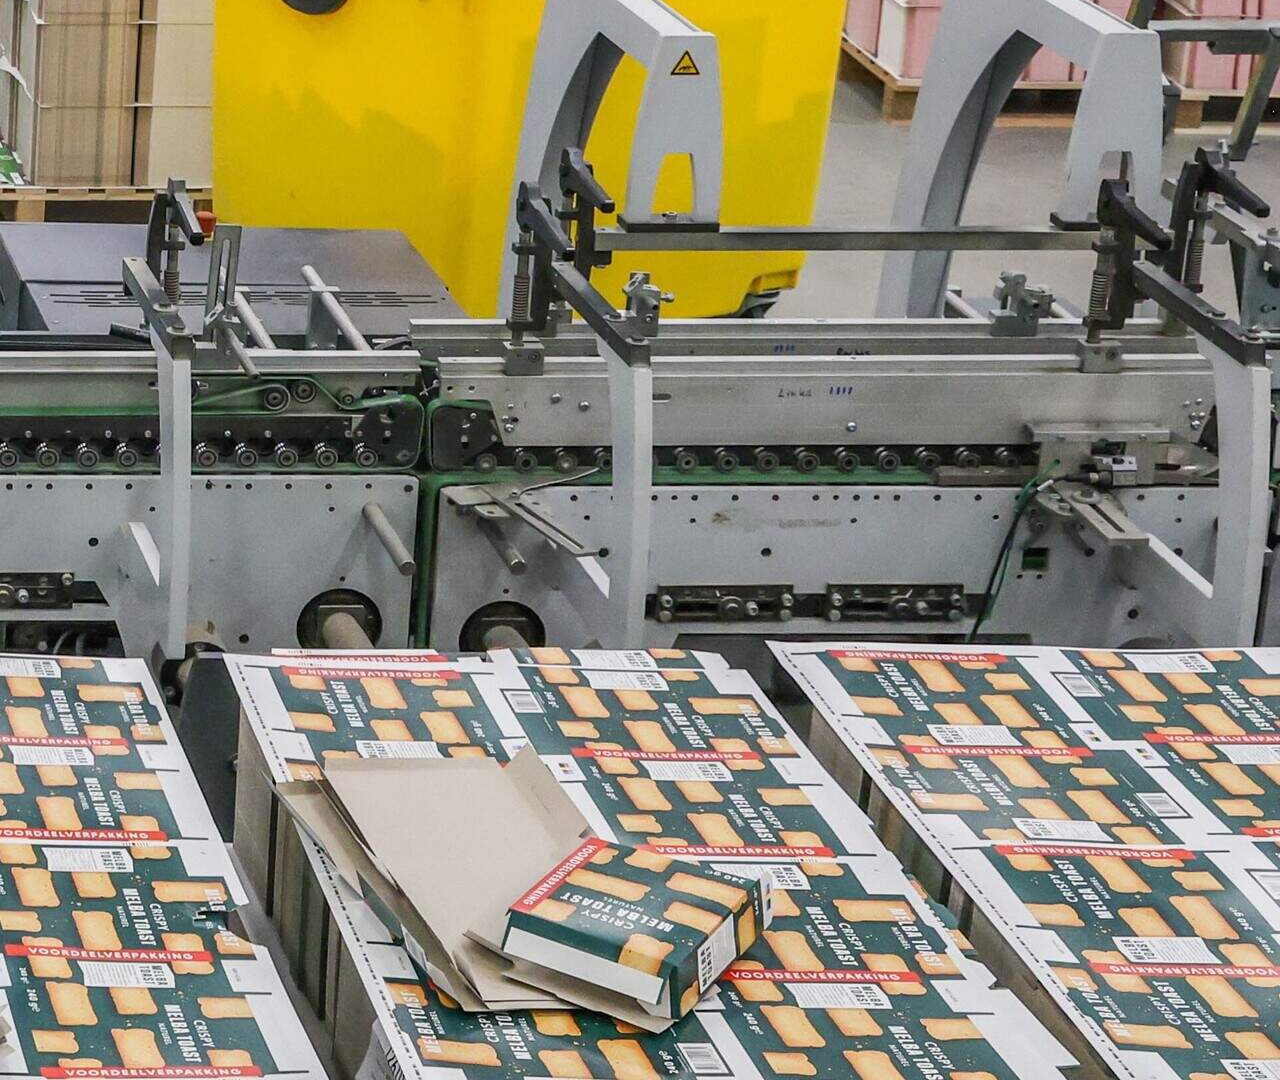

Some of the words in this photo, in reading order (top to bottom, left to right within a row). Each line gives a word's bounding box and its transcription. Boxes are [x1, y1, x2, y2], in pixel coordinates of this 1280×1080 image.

[560, 892, 613, 913] TOAST
[581, 910, 634, 929] CRISPY
[616, 908, 674, 932] MELBA
[730, 972, 900, 981] VOORDEELVERPAKKING
